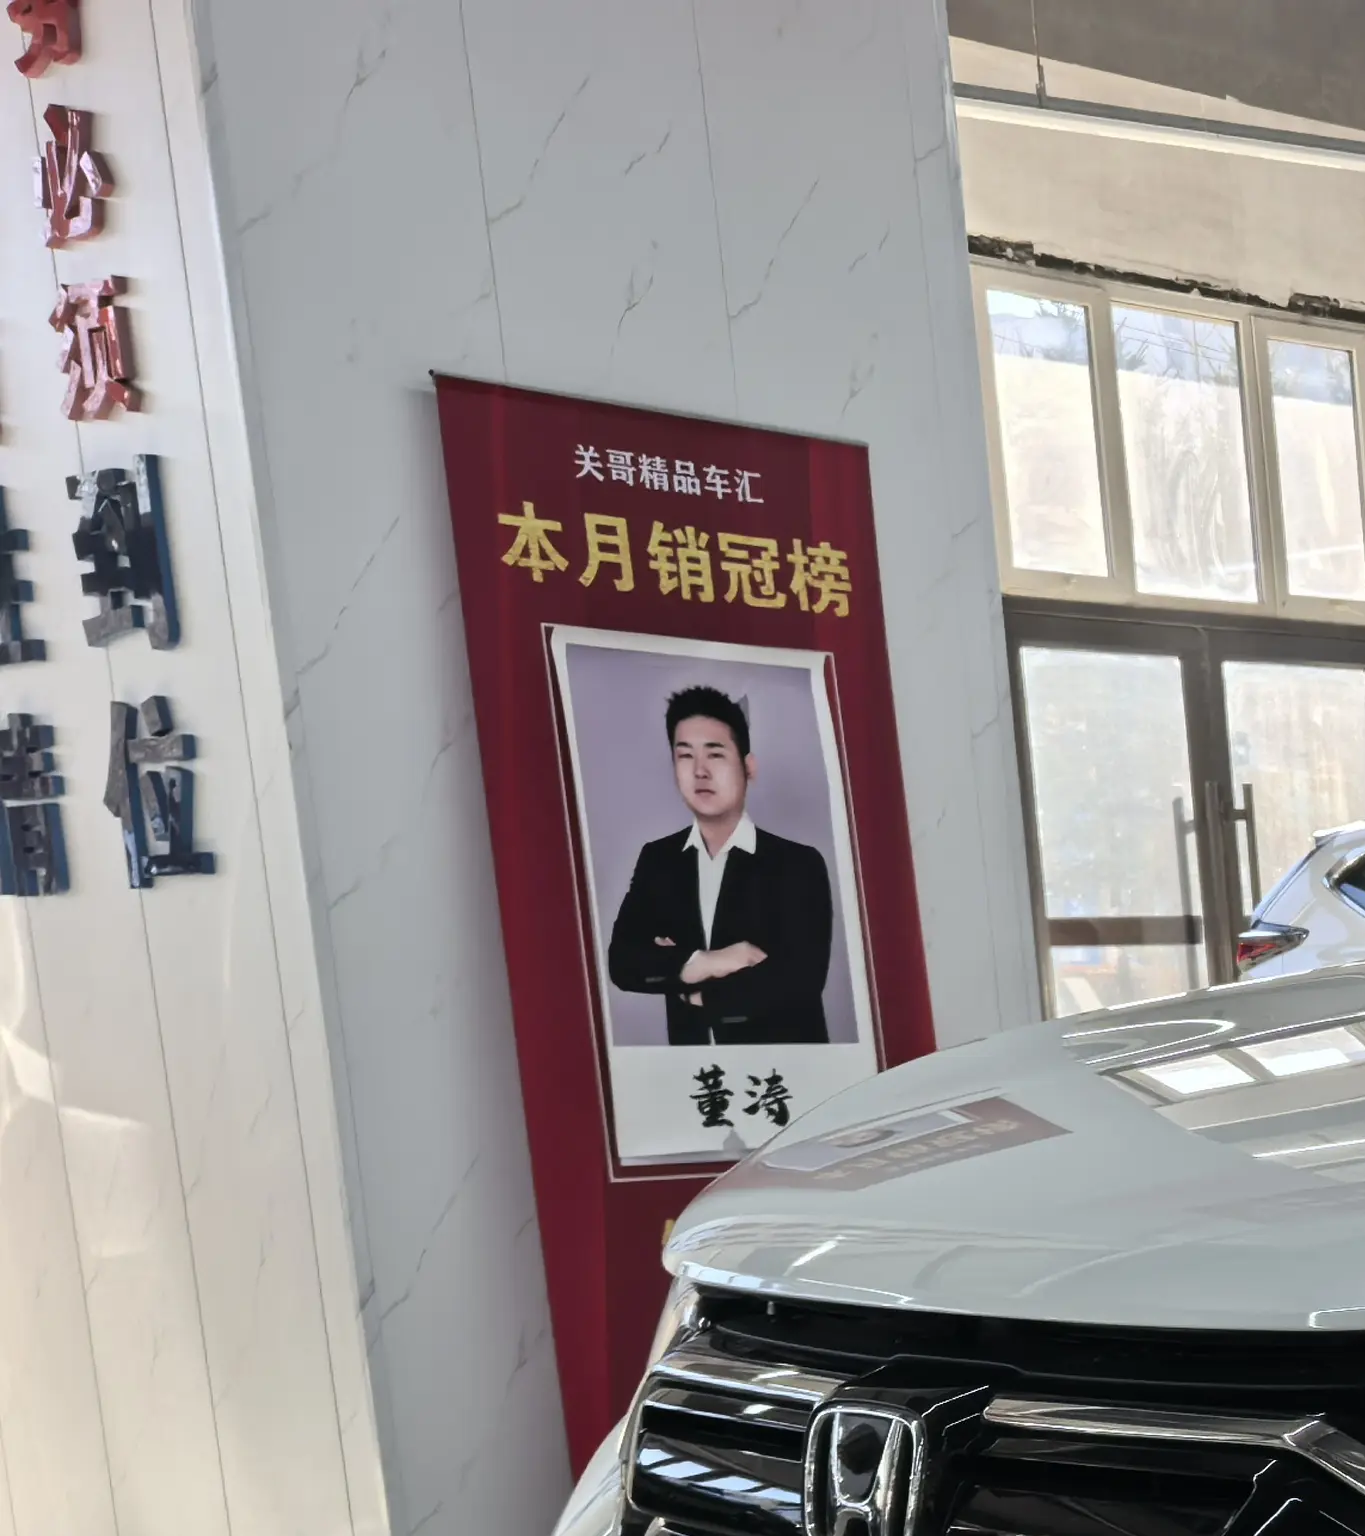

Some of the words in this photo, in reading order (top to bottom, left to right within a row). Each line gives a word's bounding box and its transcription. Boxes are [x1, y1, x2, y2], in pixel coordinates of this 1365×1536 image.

[574, 444, 764, 503] 关哥精品车汇
[497, 501, 853, 617] 本月销冠榜
[689, 1063, 794, 1129] 董涛
